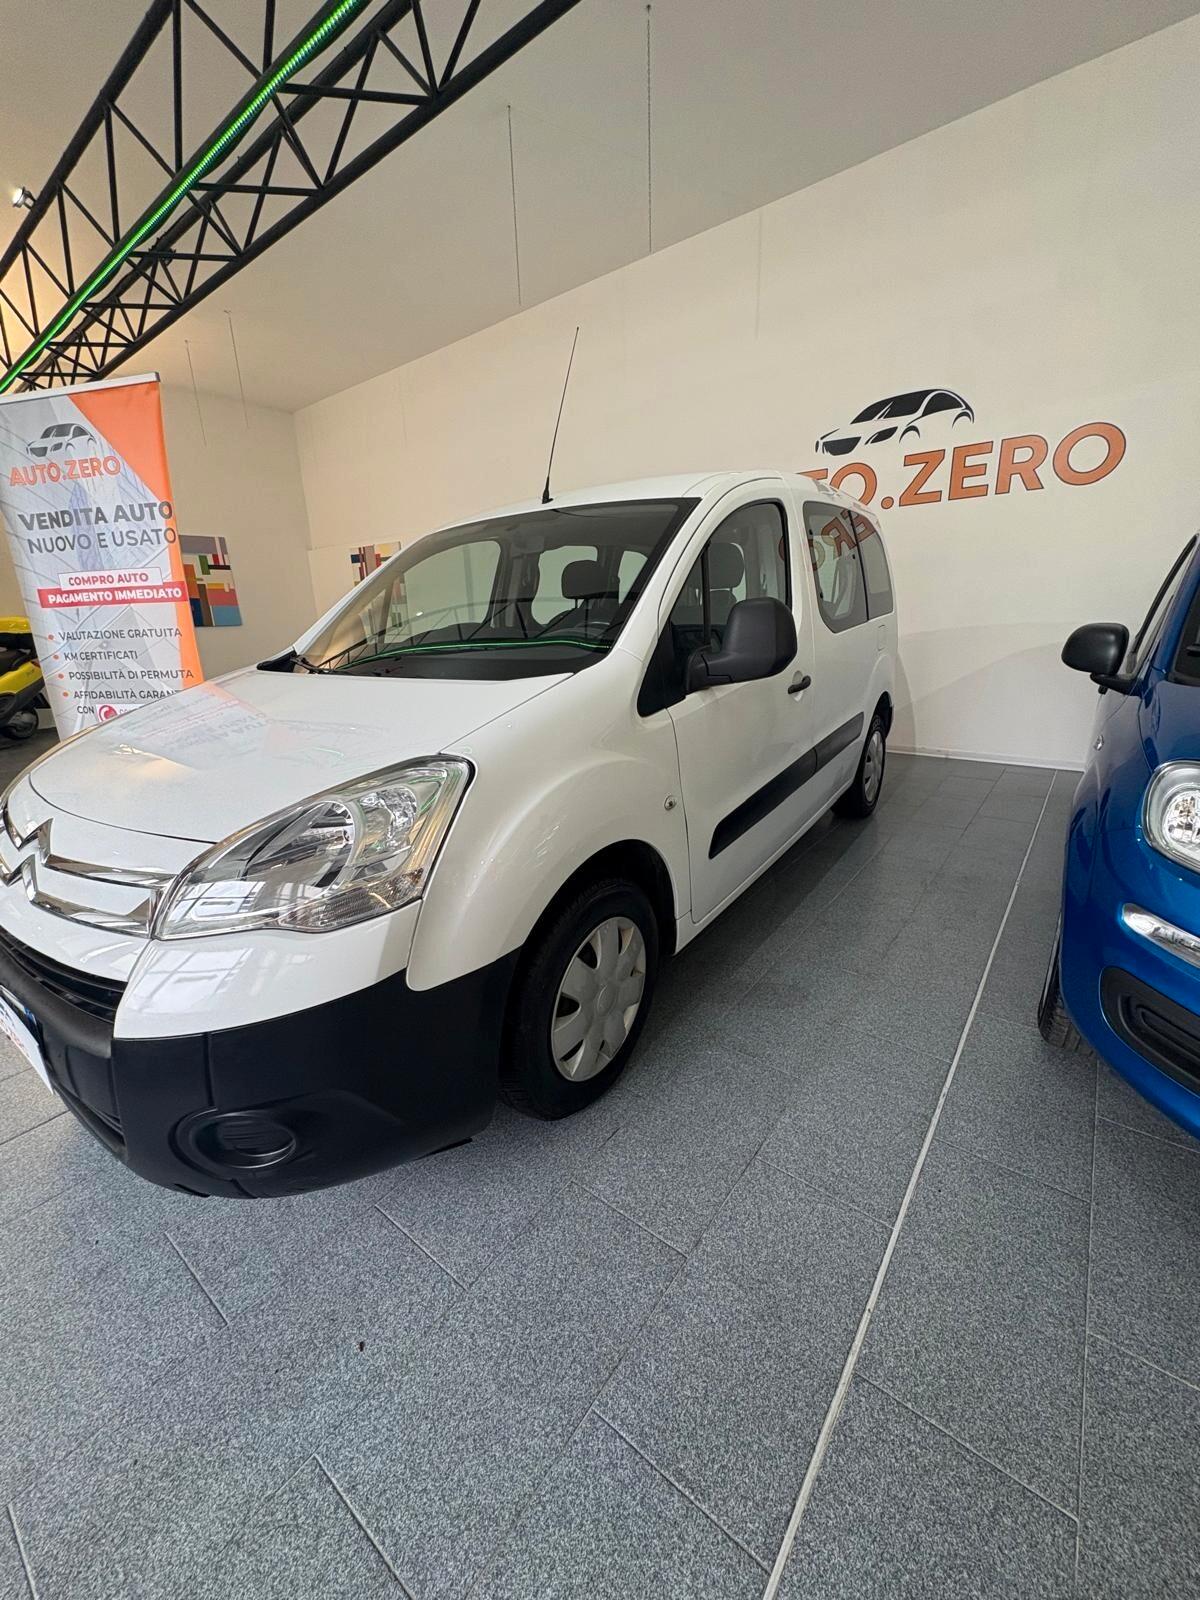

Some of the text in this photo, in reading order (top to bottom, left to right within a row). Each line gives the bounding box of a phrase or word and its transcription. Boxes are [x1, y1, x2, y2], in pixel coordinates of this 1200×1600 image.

[9, 455, 121, 486] AUTO.ZERO
[795, 421, 1127, 510] O.ZERO
[18, 501, 173, 531] VENDITA AUTO
[27, 527, 176, 554] NUOVO E USATO
[68, 572, 149, 587] COMPRO AUTO
[47, 587, 182, 604] PAGAMENTO IMMEDIATO
[58, 628, 183, 641] VALUTAZIONE GRATUITA
[64, 650, 139, 661] KM CERTIFICATI
[68, 668, 194, 680] POSSIBILITÀ DI PERMUTA
[73, 688, 137, 700] AFFIDABILITÀ
[76, 705, 95, 715] CON
